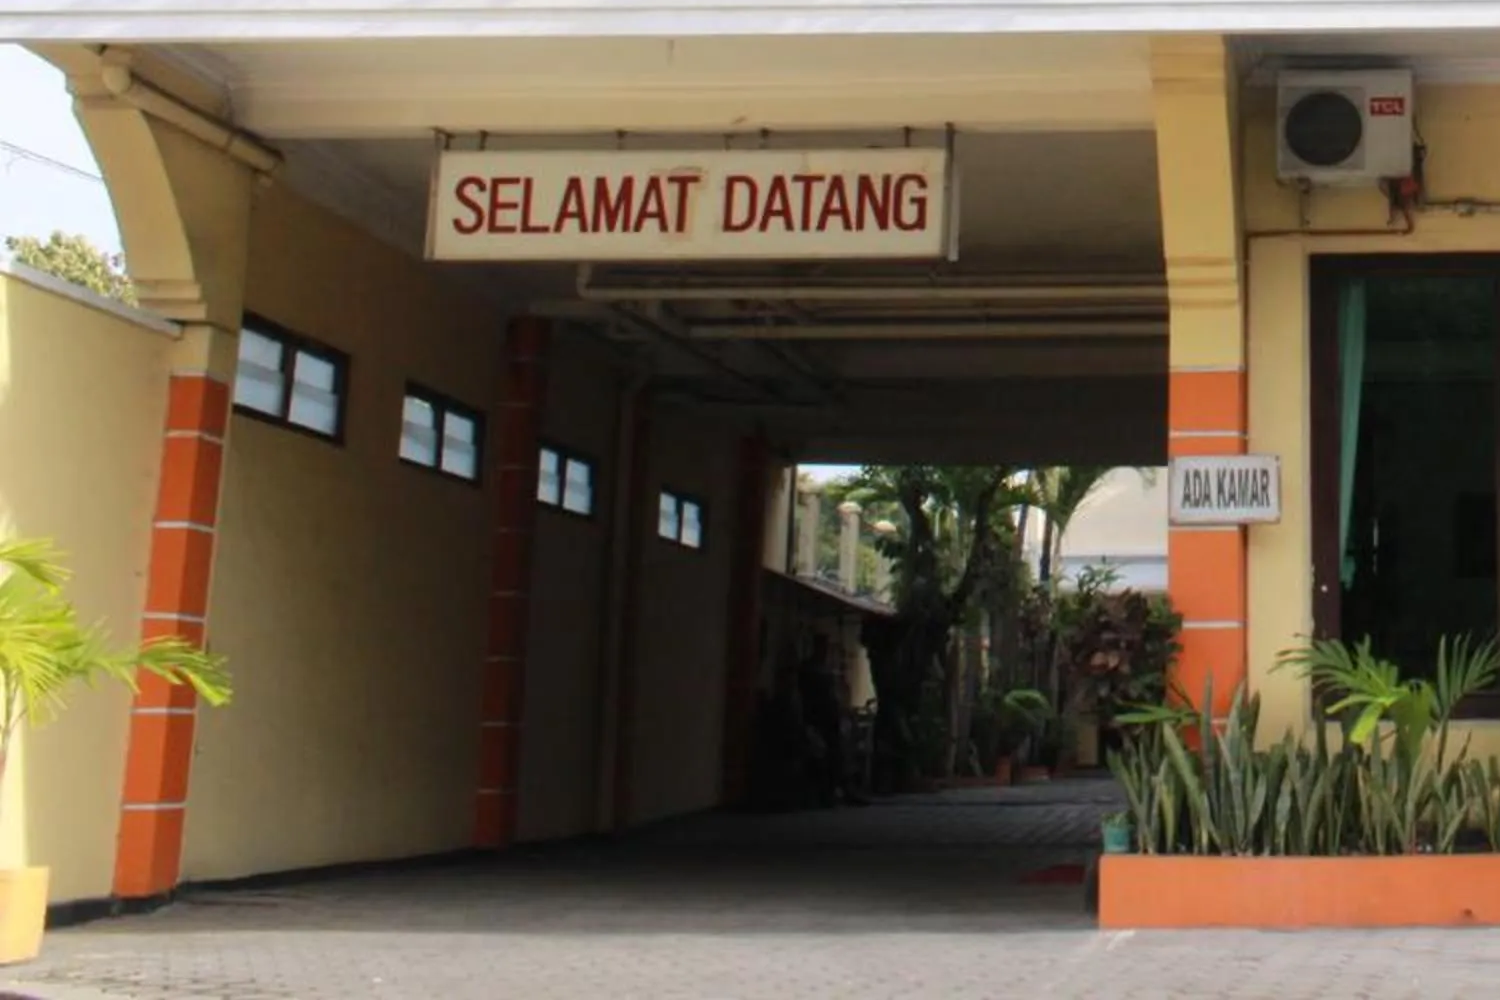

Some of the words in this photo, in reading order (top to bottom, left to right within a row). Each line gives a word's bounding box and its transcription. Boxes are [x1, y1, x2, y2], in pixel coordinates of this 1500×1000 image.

[1371, 99, 1402, 113] TCL
[453, 175, 699, 235] SELAMAT
[721, 173, 929, 232] DATANG
[1181, 468, 1213, 509] ADA
[1217, 467, 1271, 509] KAMAR
